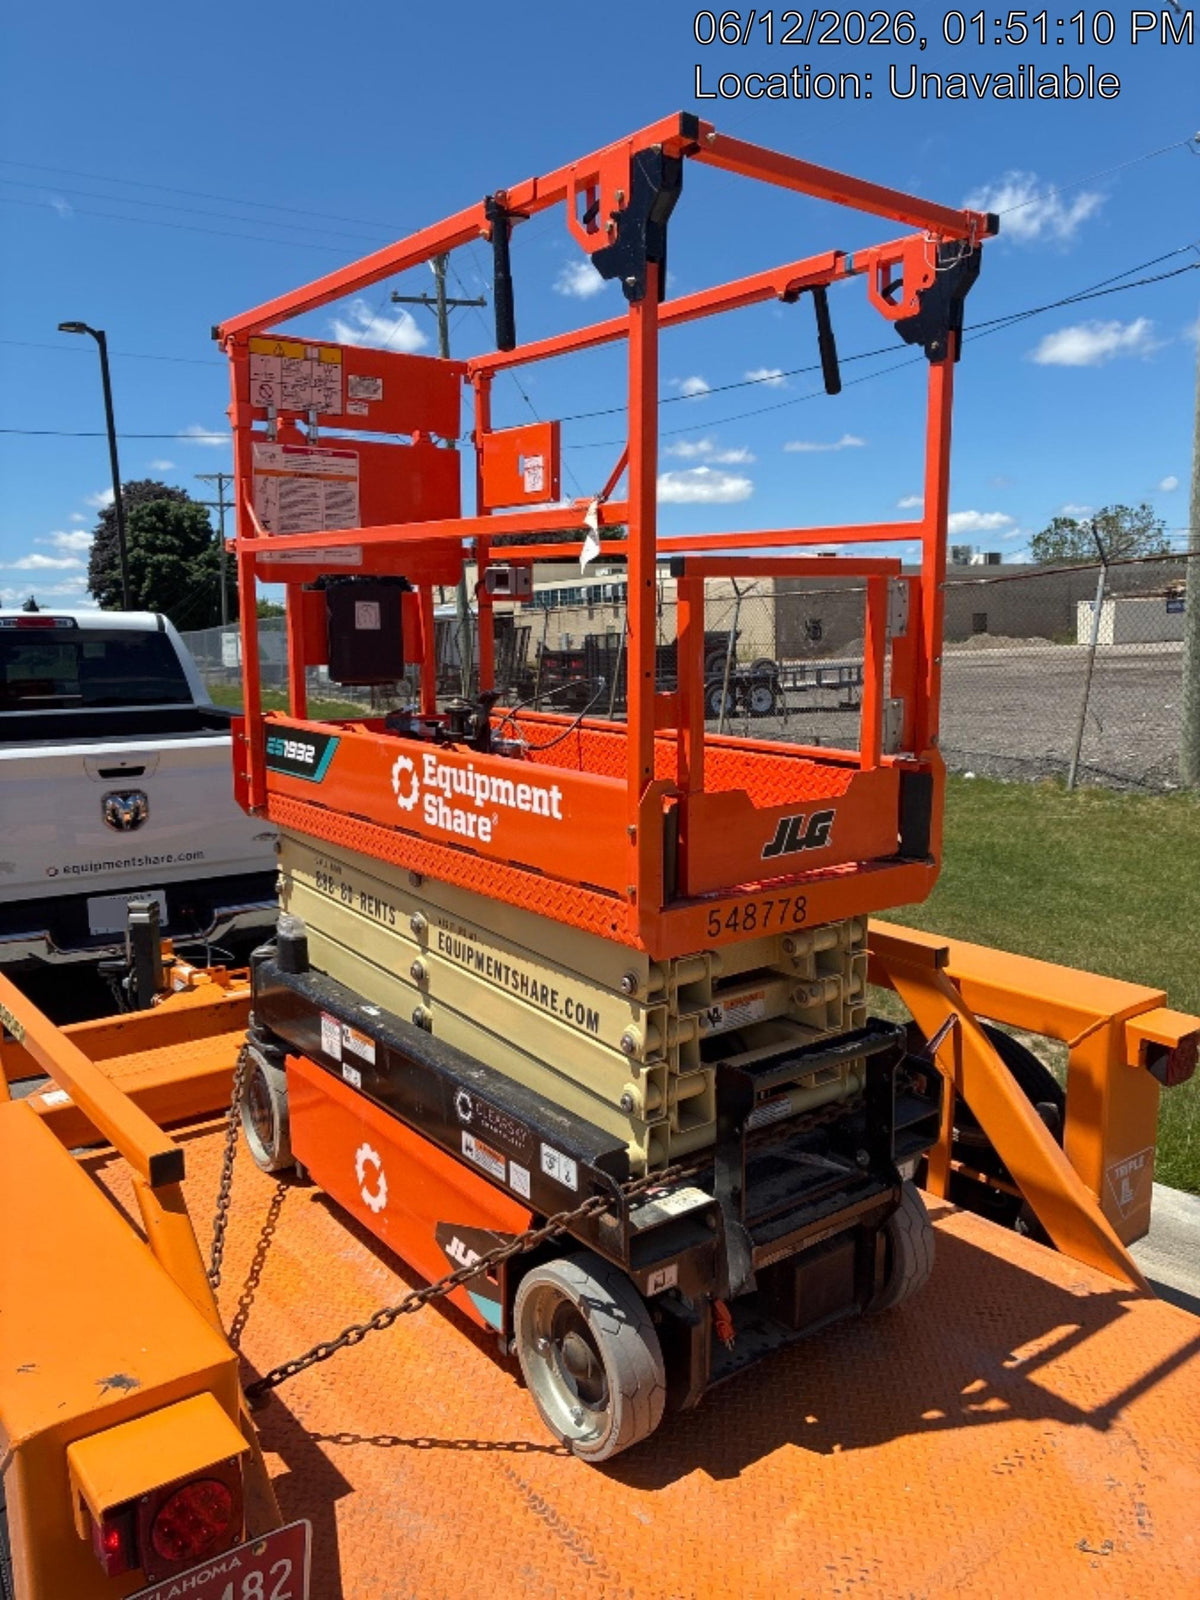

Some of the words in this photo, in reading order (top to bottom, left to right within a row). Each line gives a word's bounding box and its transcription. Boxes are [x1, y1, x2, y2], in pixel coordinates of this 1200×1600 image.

[266, 737, 316, 764] ES1932
[422, 753, 563, 820] Equipment
[761, 808, 837, 860] JLG
[63, 850, 204, 875] equipmentshare.com
[707, 896, 807, 938] 548778
[438, 931, 600, 1034] EQUIPMENTSHARE.COM
[148, 1556, 242, 1600] LAHOMA
